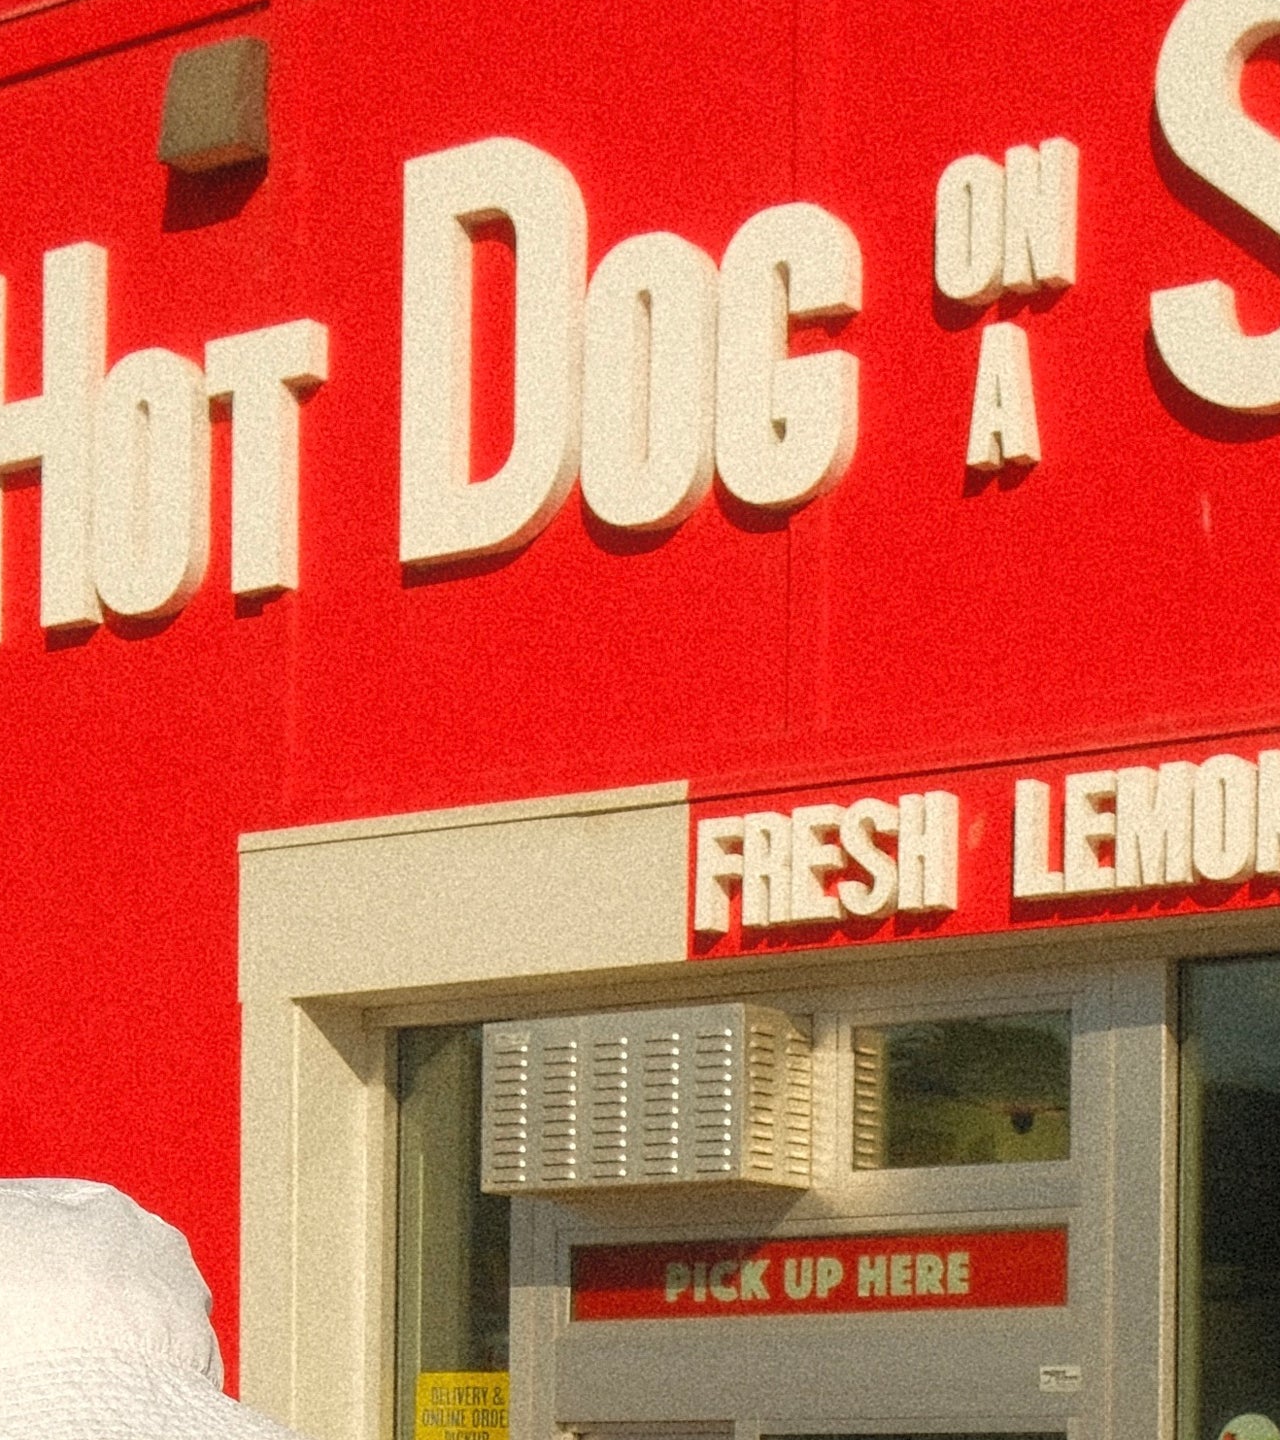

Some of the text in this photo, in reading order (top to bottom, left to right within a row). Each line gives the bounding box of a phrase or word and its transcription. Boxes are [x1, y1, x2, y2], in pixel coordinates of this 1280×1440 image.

[934, 137, 1080, 306] ON
[965, 321, 1042, 472] A
[693, 789, 960, 935] FRESH
[664, 1251, 970, 1303] PICK UP HERE
[422, 1408, 508, 1429] ONLINE ORDE
[431, 1386, 505, 1406] DELIVERY &
